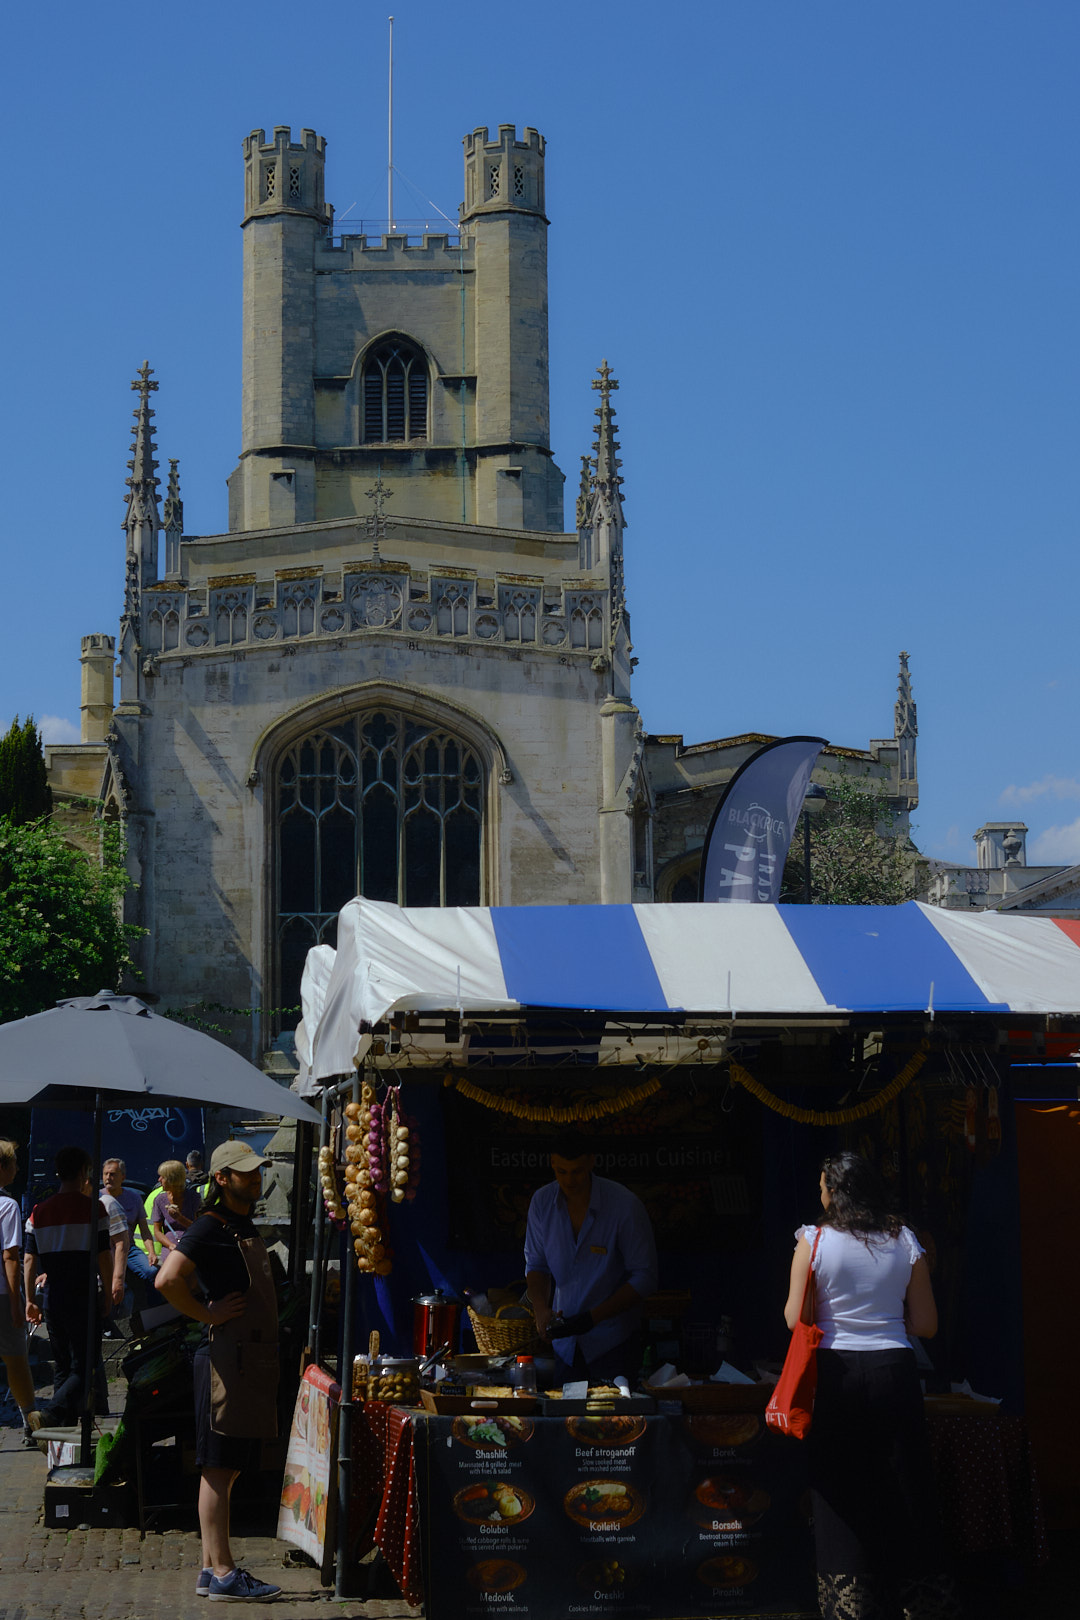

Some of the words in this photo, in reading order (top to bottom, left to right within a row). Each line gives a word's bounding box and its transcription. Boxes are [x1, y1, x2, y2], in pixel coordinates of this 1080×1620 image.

[719, 843, 756, 903] PA
[593, 1151, 650, 1172] opean
[655, 1147, 722, 1168] Cuisine
[475, 1449, 508, 1459] Shashlik
[575, 1447, 594, 1457] Beef
[595, 1446, 636, 1459] stroganoff
[609, 1465, 632, 1473] potatoes
[617, 1535, 636, 1543] garnish
[699, 1533, 721, 1541] Beetroot
[479, 1592, 515, 1602] Medovik
[568, 1604, 589, 1612] Cookies
